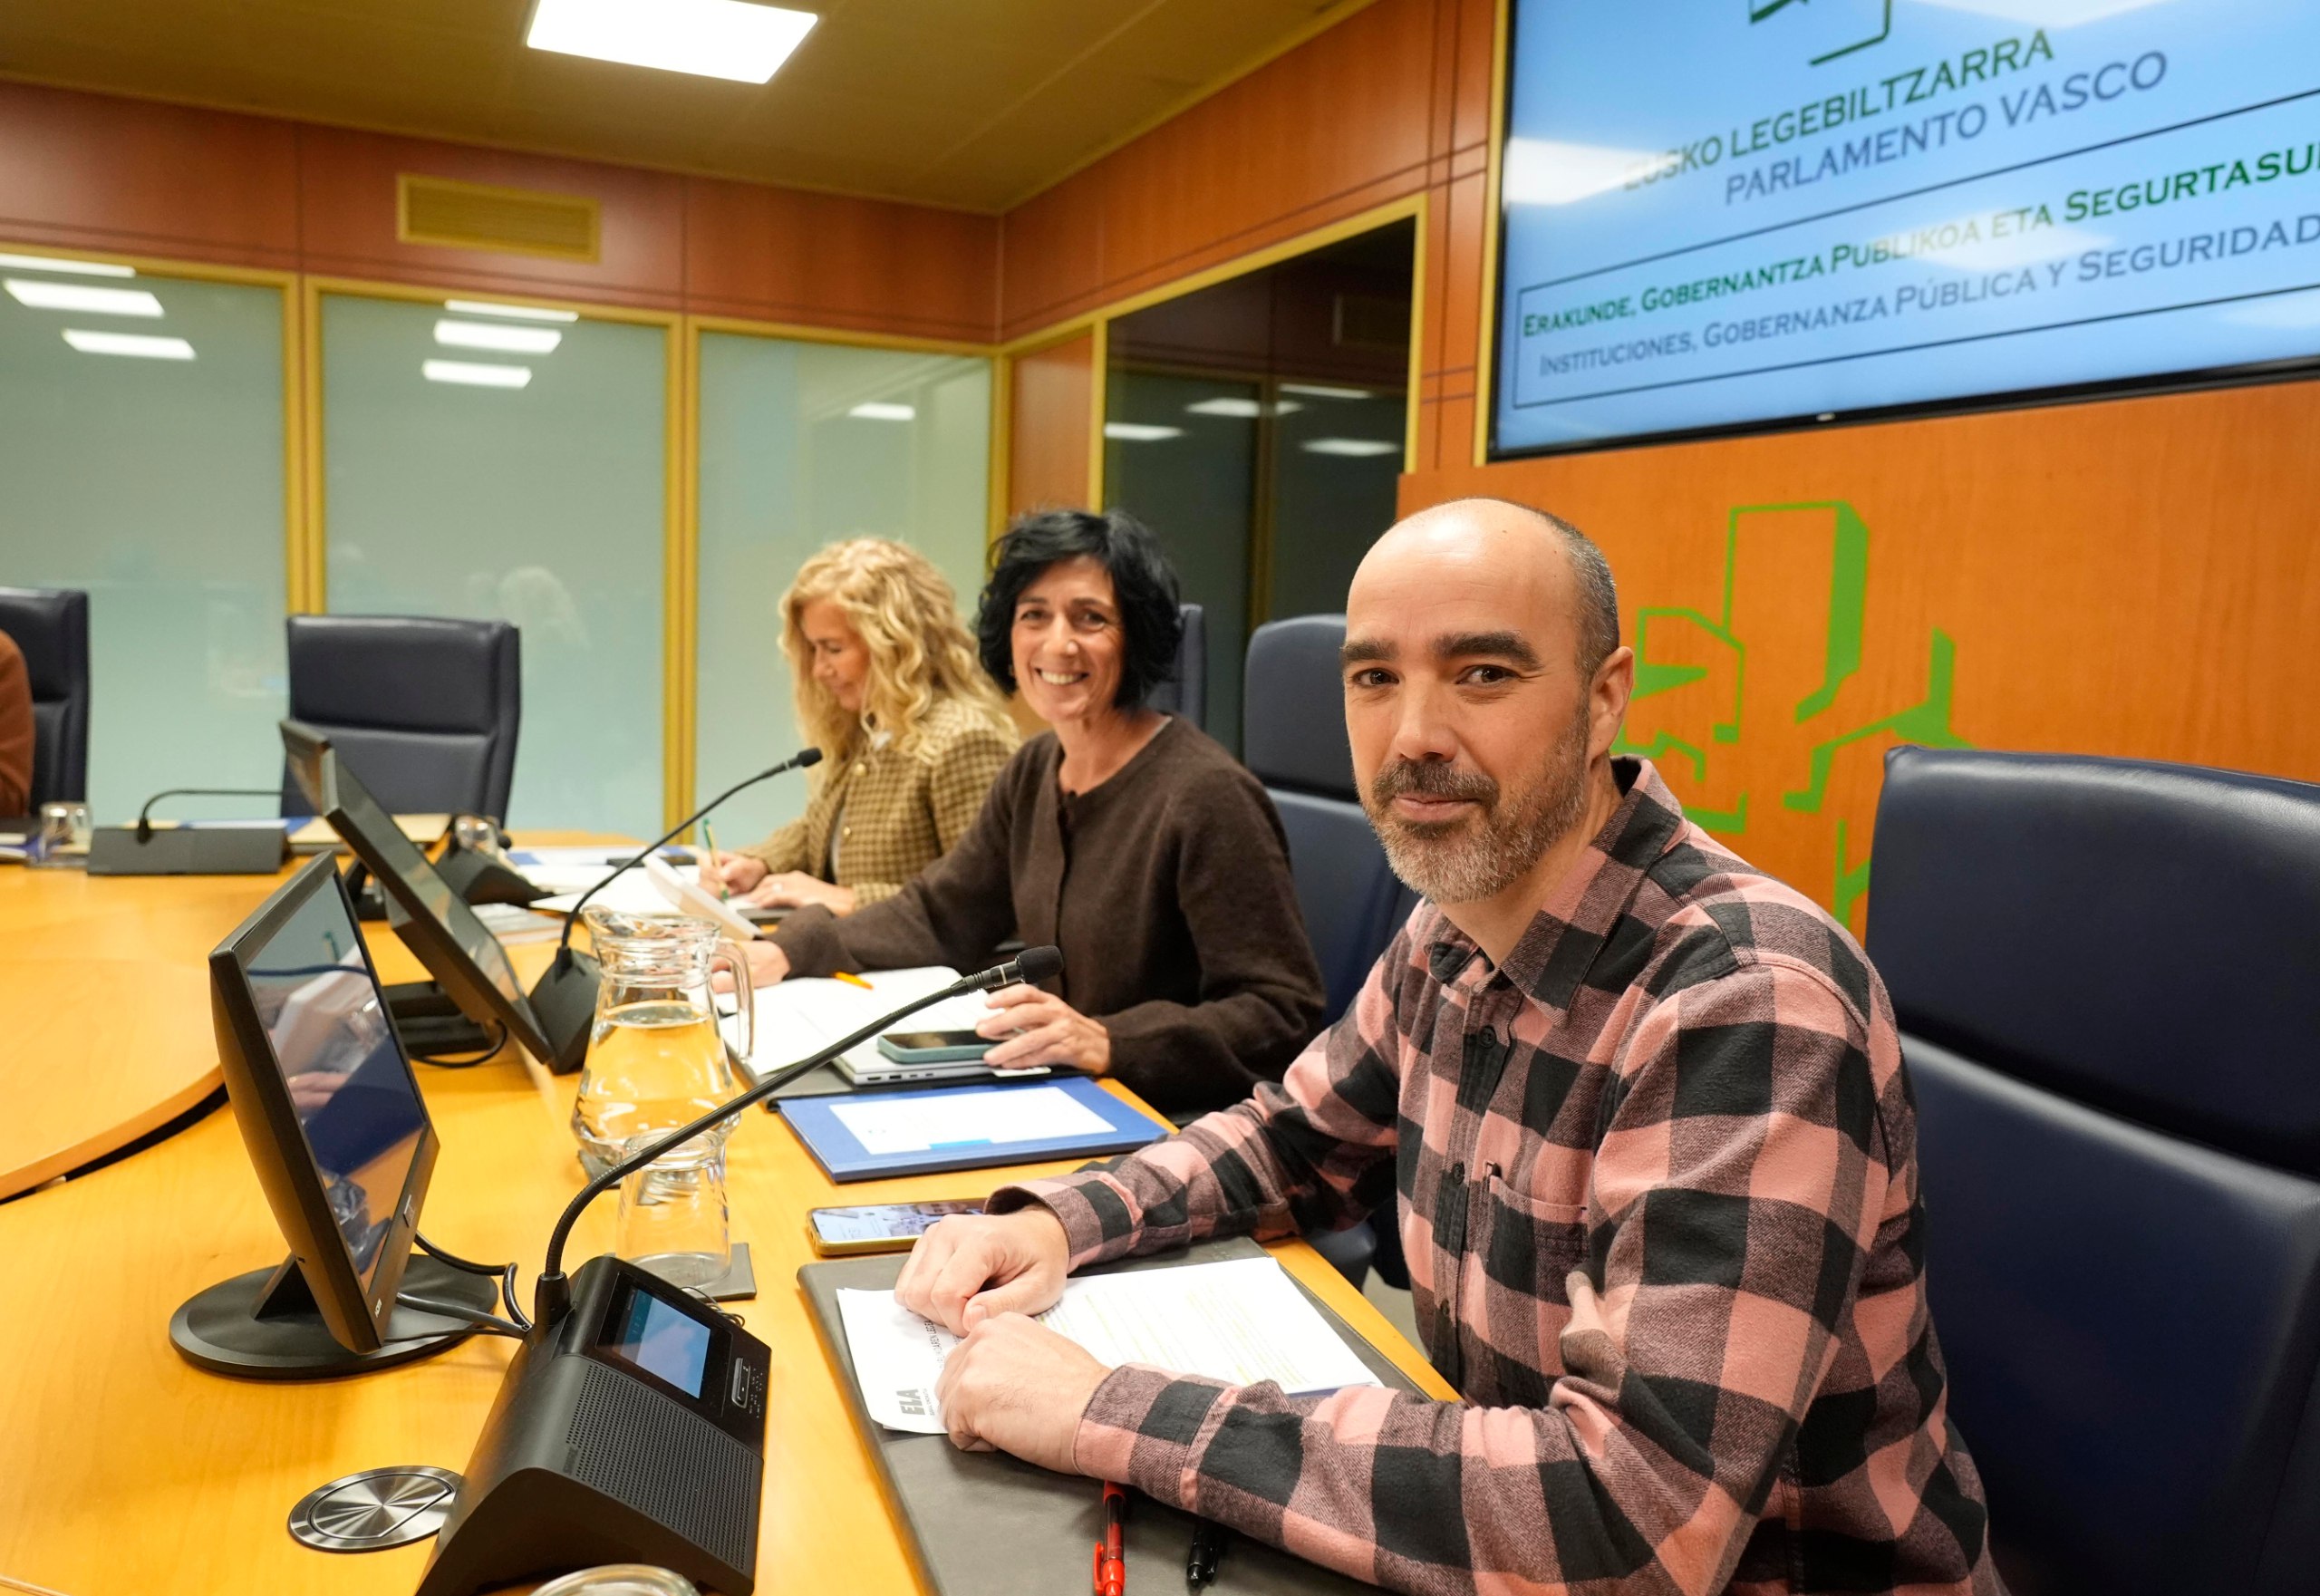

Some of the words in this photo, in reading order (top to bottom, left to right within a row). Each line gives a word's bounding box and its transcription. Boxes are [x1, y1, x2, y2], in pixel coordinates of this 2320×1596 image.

[1625, 135, 1724, 192] EUSKO
[1730, 28, 2054, 160] LEGEBILTZARRA
[1726, 103, 1987, 207] PARLAMENTO
[1999, 50, 2169, 128] VASCO
[1990, 203, 2054, 238] ETA
[2064, 141, 2320, 223] SEGURTASU
[2045, 260, 2068, 288] Y
[895, 1389, 926, 1416] ELA
